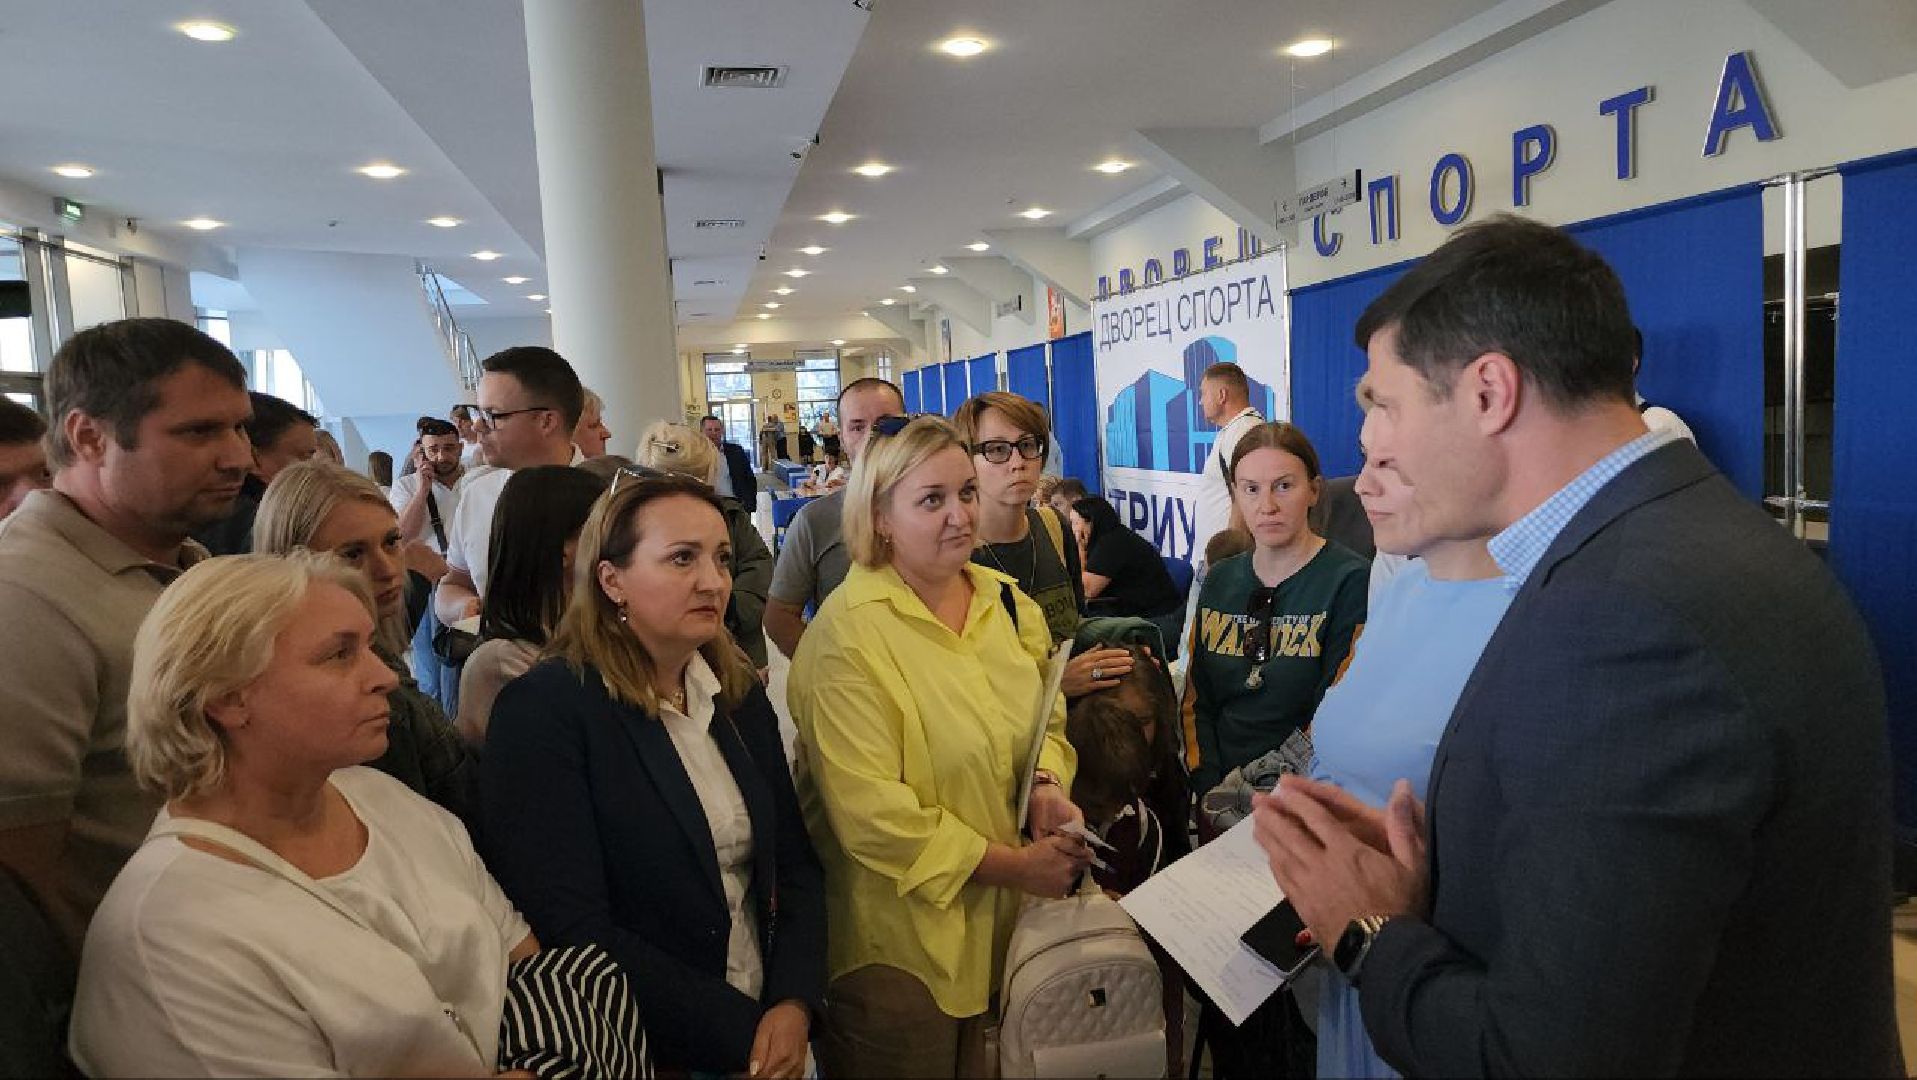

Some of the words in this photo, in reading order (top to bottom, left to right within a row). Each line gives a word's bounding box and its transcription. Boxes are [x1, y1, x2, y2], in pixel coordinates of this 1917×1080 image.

[1313, 50, 1781, 257] СПОРТА
[1099, 298, 1173, 351] ДВОРЕЦ
[1177, 274, 1275, 332] СПОРТА
[1108, 489, 1197, 560] ТРИУ
[1201, 608, 1326, 657] WAICK
